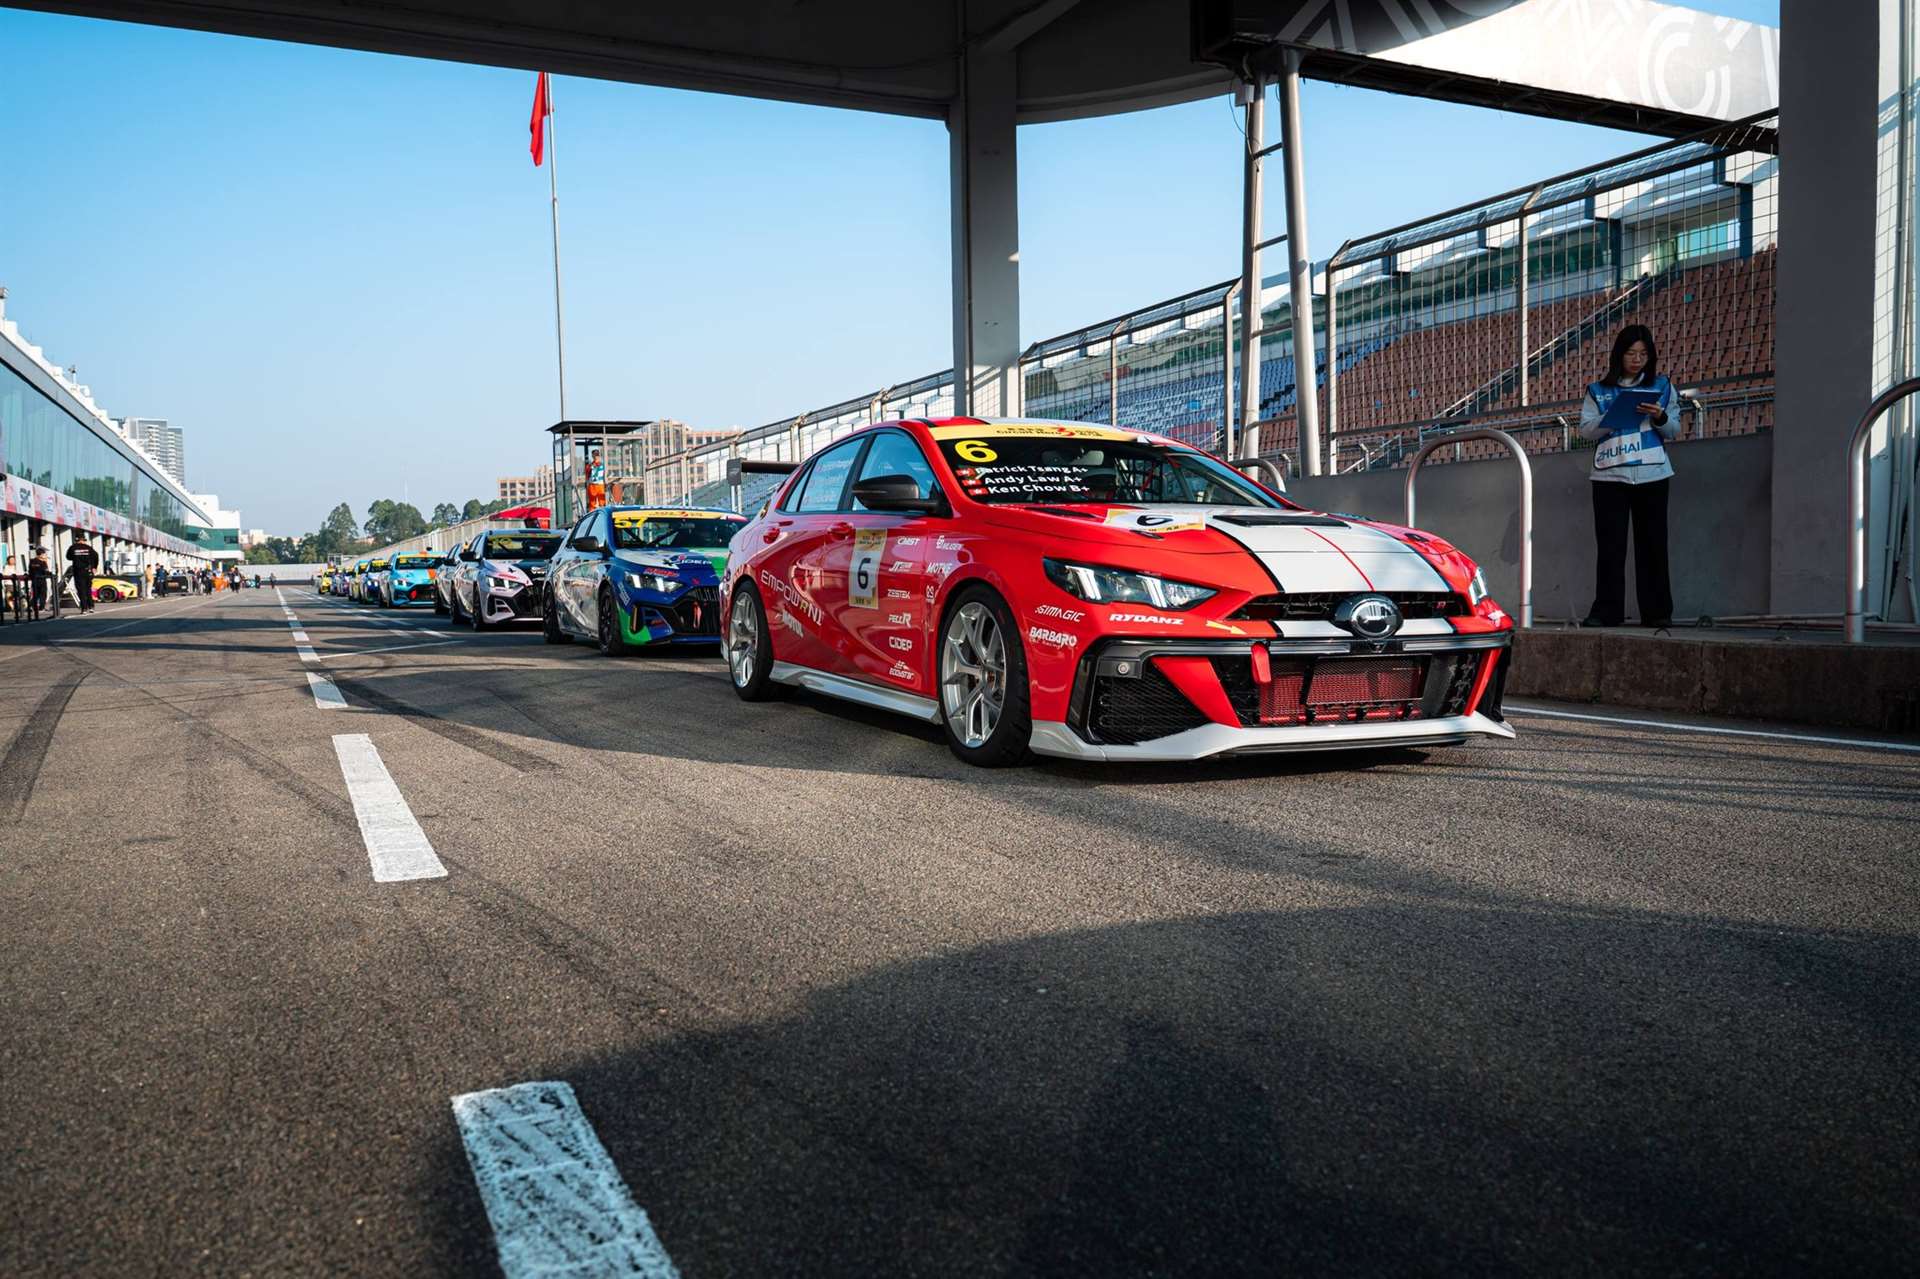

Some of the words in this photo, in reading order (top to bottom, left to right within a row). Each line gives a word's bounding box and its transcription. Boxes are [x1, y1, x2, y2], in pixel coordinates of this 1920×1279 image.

[954, 440, 998, 463] 6
[1596, 441, 1641, 463] ZHUHAI
[1028, 465, 1071, 474] Tsang
[984, 475, 1025, 485] Andy
[1027, 475, 1061, 483] Law
[987, 485, 1020, 494] Ken
[1022, 484, 1067, 493] Chow
[1070, 484, 1091, 493] B+
[857, 557, 872, 590] 6
[1035, 604, 1086, 623] SIMAGIC
[1109, 613, 1185, 625] RYDANZ
[1028, 626, 1078, 648] BARBARO
